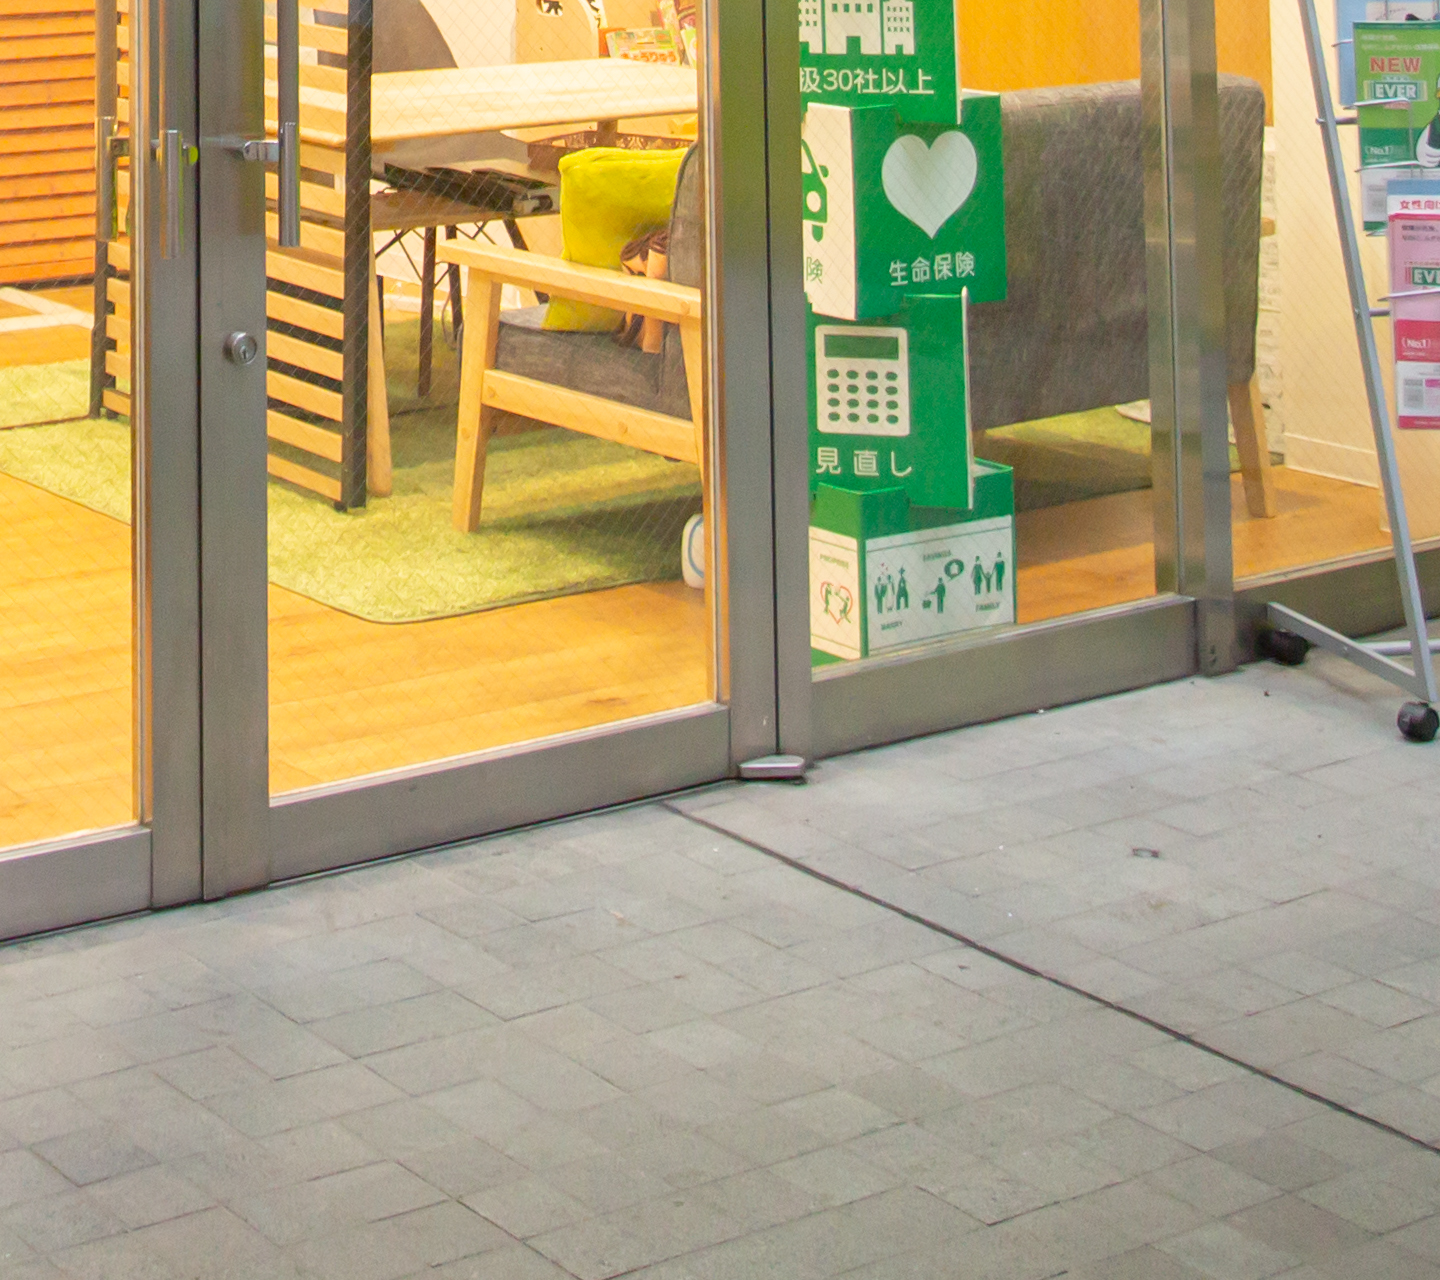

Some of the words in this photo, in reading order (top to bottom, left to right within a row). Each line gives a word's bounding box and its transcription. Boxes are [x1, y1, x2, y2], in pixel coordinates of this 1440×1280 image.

[1370, 57, 1421, 73] NEW
[1375, 84, 1416, 98] EVER
[889, 251, 976, 287] 生命保険
[816, 447, 913, 478] 見直し
